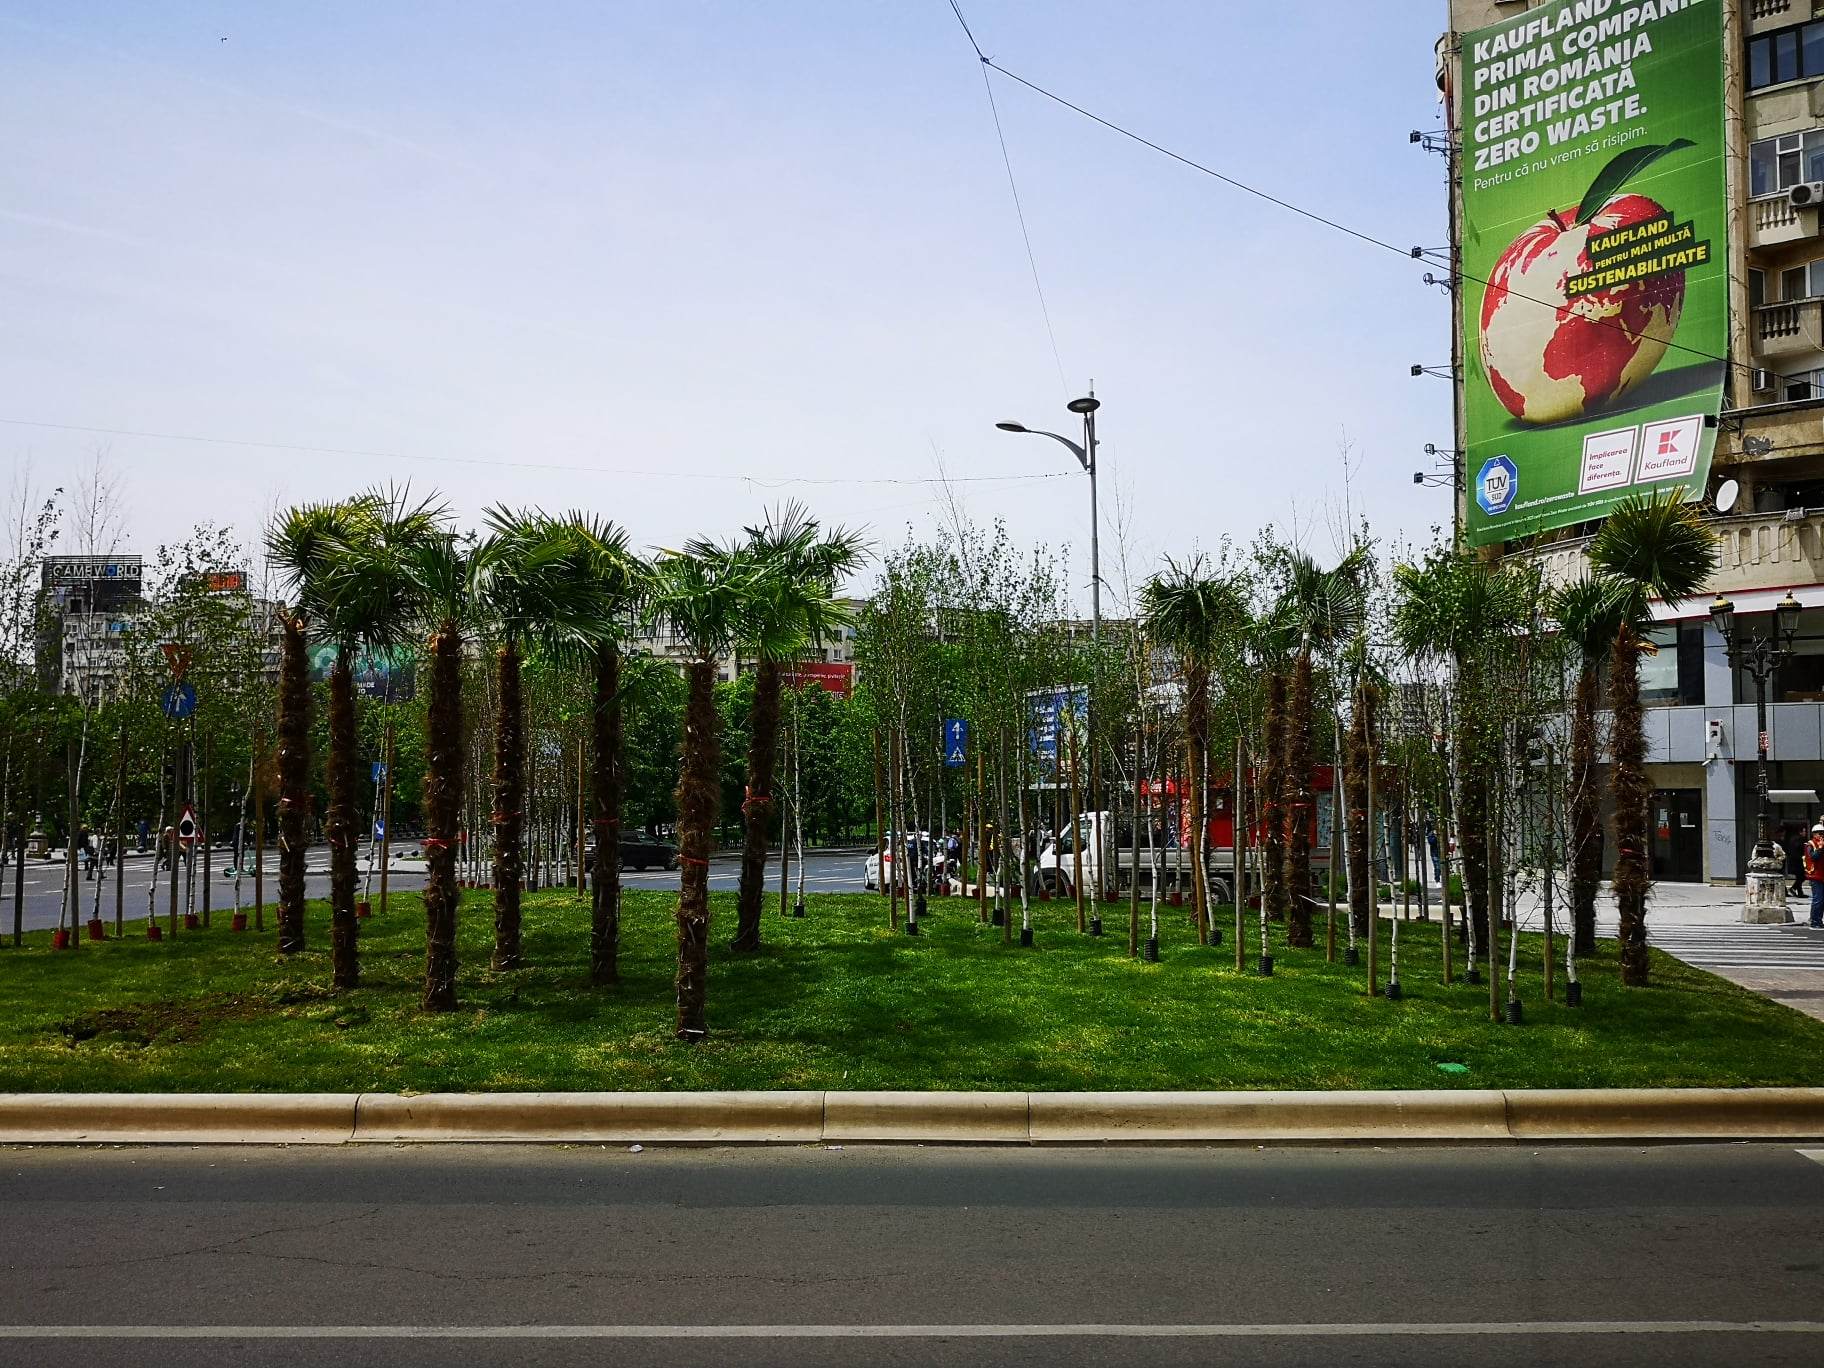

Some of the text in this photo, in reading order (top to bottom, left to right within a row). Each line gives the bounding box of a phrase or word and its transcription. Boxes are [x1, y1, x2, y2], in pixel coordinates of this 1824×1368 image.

[1474, 0, 1612, 64] KAUFLAND
[1474, 0, 1702, 90] PRIMA COMPAN
[1474, 31, 1653, 117] DIN ROMÂNIA
[1474, 60, 1636, 143] CERTIFICATĂ
[1474, 93, 1648, 172] ZERO WASTE.
[1474, 124, 1648, 192] Pentru că nu vrem să risipim.
[1591, 219, 1669, 254] KAUFLAND
[1595, 226, 1691, 270] PENTRU MAI MULTĂ
[1568, 245, 1707, 294] SUSTENABILITATE
[1588, 462, 1604, 471] face
[1589, 447, 1628, 461] Implicarea
[1644, 456, 1688, 471] Kaufland
[53, 564, 139, 577] GAMEWORLD
